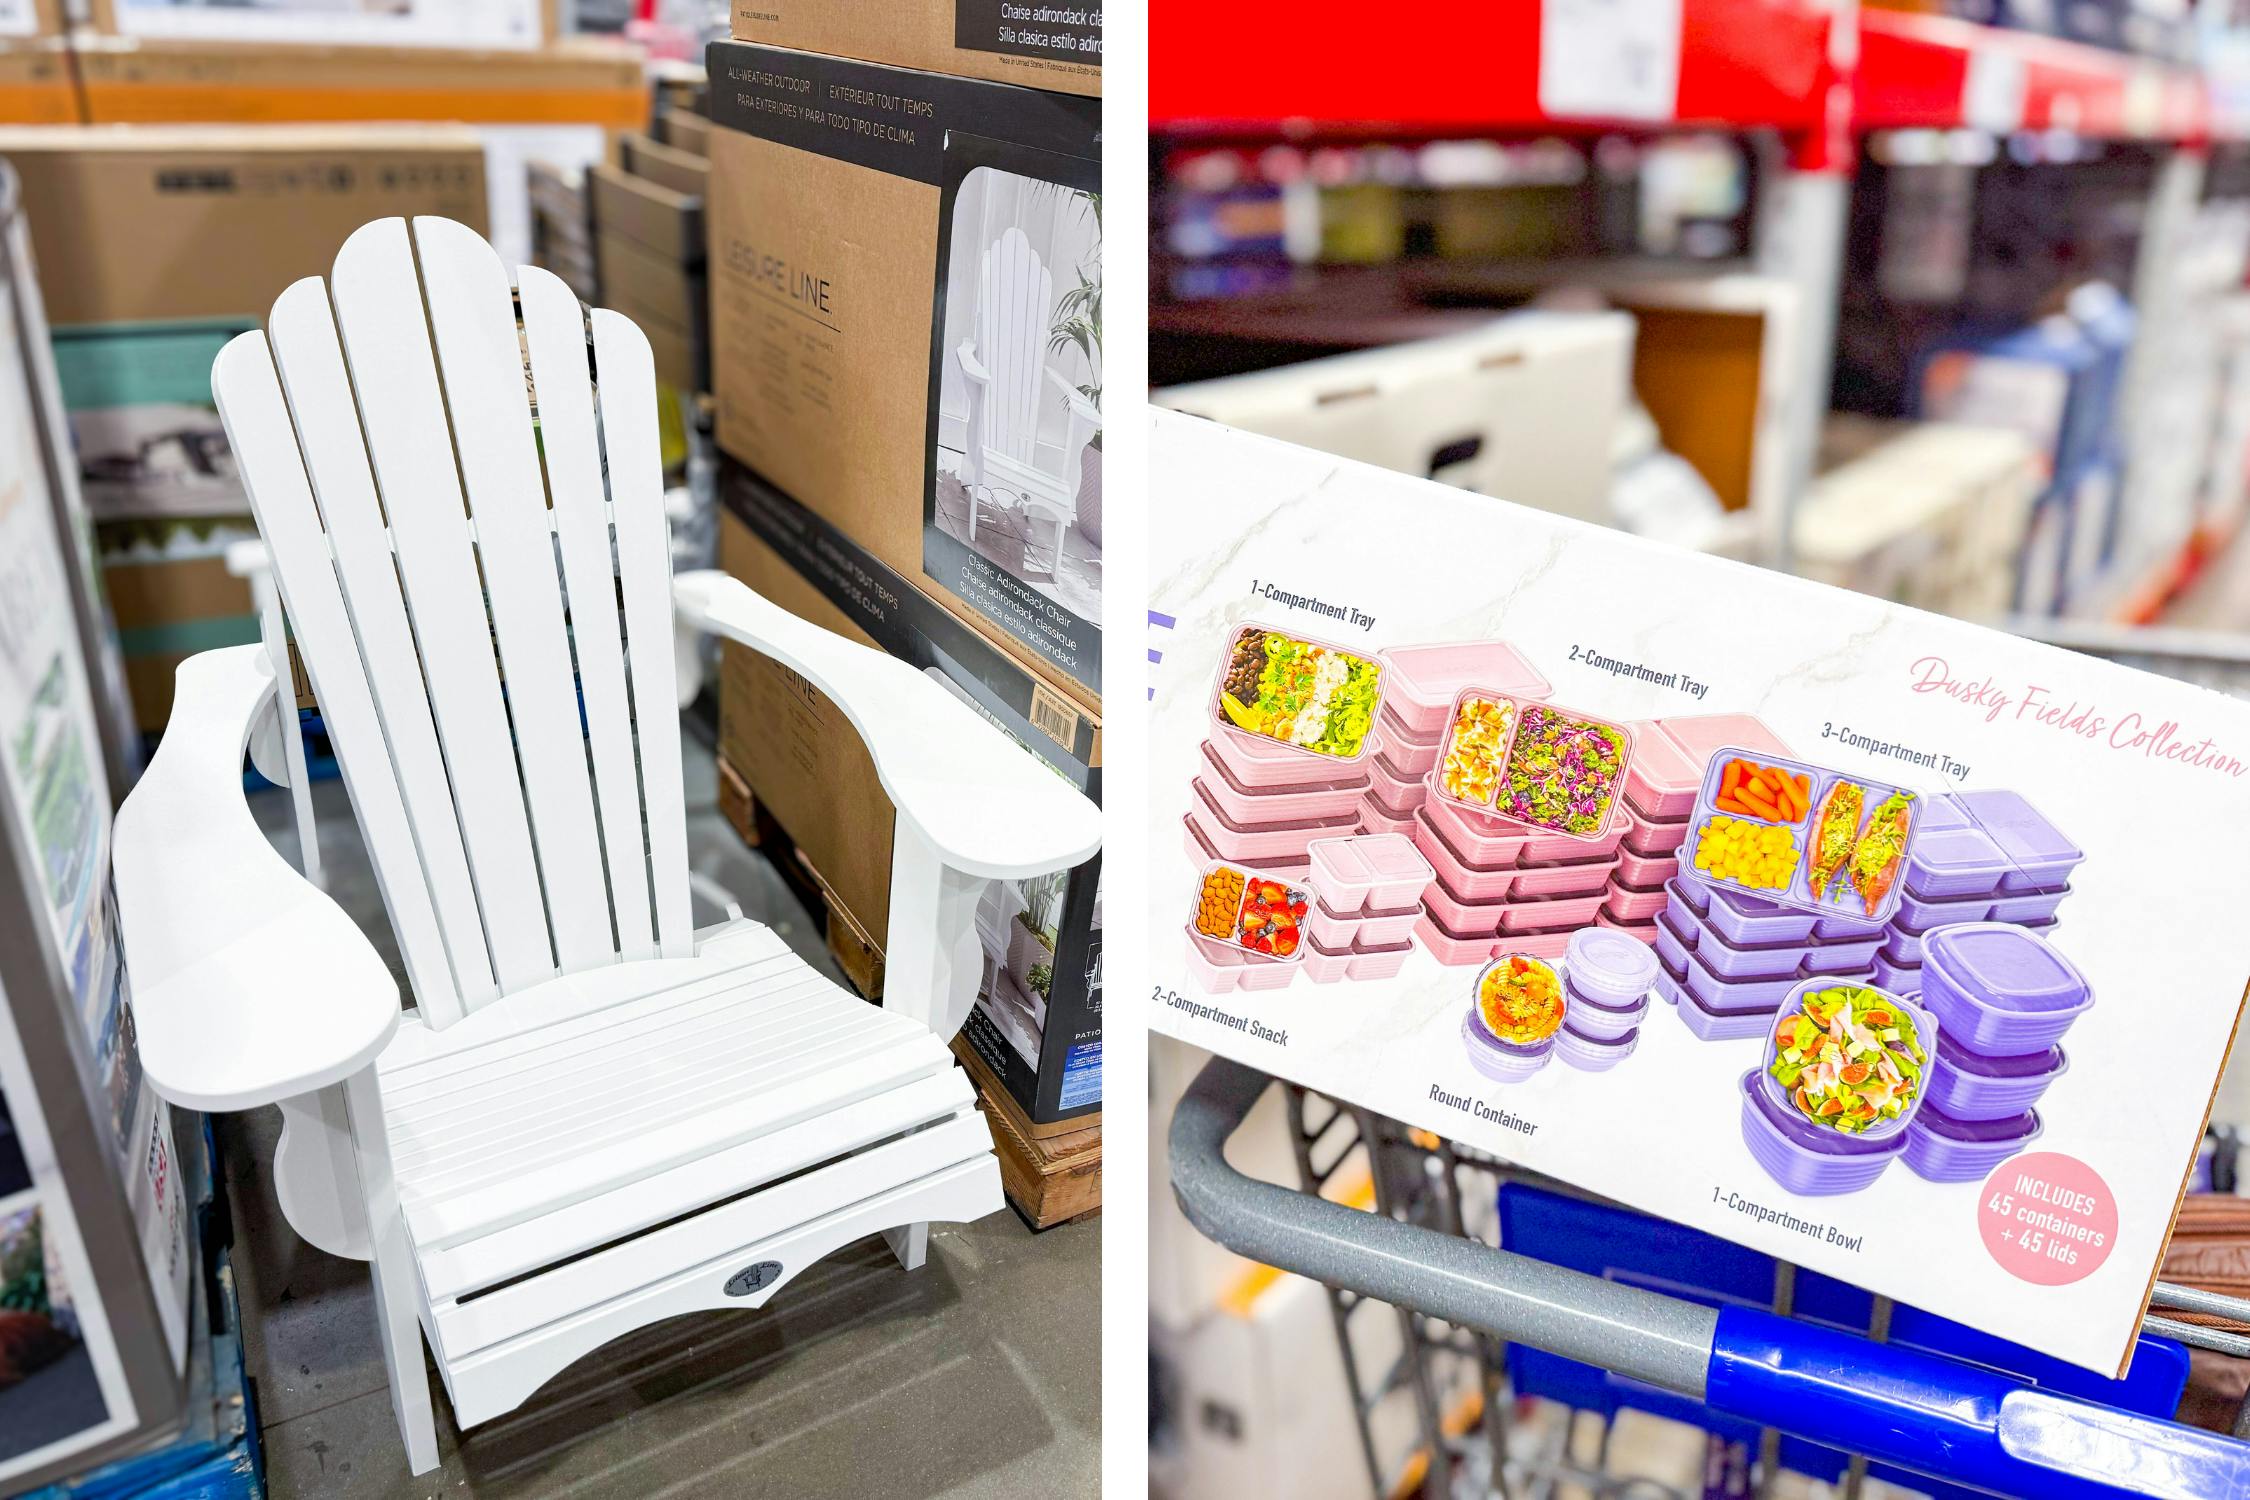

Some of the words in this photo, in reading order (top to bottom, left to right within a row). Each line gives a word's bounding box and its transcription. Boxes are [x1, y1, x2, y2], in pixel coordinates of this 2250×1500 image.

[998, 26, 1016, 43] Silla
[1018, 28, 1048, 47] clasica
[1051, 33, 1076, 50] estilo
[1001, 3, 1031, 21] Chaise
[1032, 6, 1087, 26] adirondack
[728, 66, 773, 87] ALL-WEATHER
[774, 74, 811, 94] OUTDOOR
[829, 84, 874, 107] EXTÉRIEUR
[876, 93, 901, 111] TOUT
[902, 98, 934, 118] TEMPS
[737, 93, 754, 108] PARA
[755, 97, 797, 118] EXTERIORES
[798, 106, 804, 120] Y
[805, 108, 825, 126] PARA
[827, 112, 850, 130] TODO
[852, 118, 871, 135] TIPO
[873, 123, 885, 138] DE
[887, 126, 916, 146] CLIMA
[862, 595, 885, 623] CLIMA
[875, 582, 899, 610] TEMPS
[961, 566, 987, 591] Chaise
[988, 585, 1034, 624] adirondack
[1035, 617, 1077, 652] classique
[968, 554, 995, 580] Classic
[996, 572, 1044, 613] Adirondack
[1046, 605, 1072, 630] Chair
[1251, 579, 1348, 621] 1-Compartment
[1349, 607, 1376, 632] Tray
[959, 581, 975, 600] Silla
[976, 593, 1003, 619] clasica
[1004, 613, 1026, 635] estilo
[1027, 629, 1078, 670] adirondack
[1568, 644, 1678, 689] 2-Compartment
[1680, 674, 1709, 701] Tray
[1910, 656, 2013, 722] Dusky
[2015, 685, 2106, 738] Fields
[2109, 712, 2249, 777] Collection
[1821, 722, 1938, 769] 3-Compartment
[1940, 754, 1971, 782] Tray
[983, 1019, 1002, 1045] Chair
[1075, 1029, 1102, 1040] PATIO
[1152, 985, 1249, 1032] 2-Compartment
[1250, 1019, 1289, 1047] Snack
[968, 1030, 1007, 1080] adirondack
[974, 1024, 1007, 1066] classique
[1429, 1083, 1472, 1112] Round
[1473, 1100, 1538, 1136] Container
[1713, 1186, 1824, 1239] 1-Compartment
[1826, 1225, 1863, 1253] Bowl
[1987, 1192, 2014, 1217] 45
[2016, 1206, 2105, 1247] containers
[2014, 1173, 2096, 1216] INCLUDES
[2000, 1228, 2014, 1241] +
[2018, 1229, 2045, 1253] 45
[2046, 1238, 2078, 1265] lids
